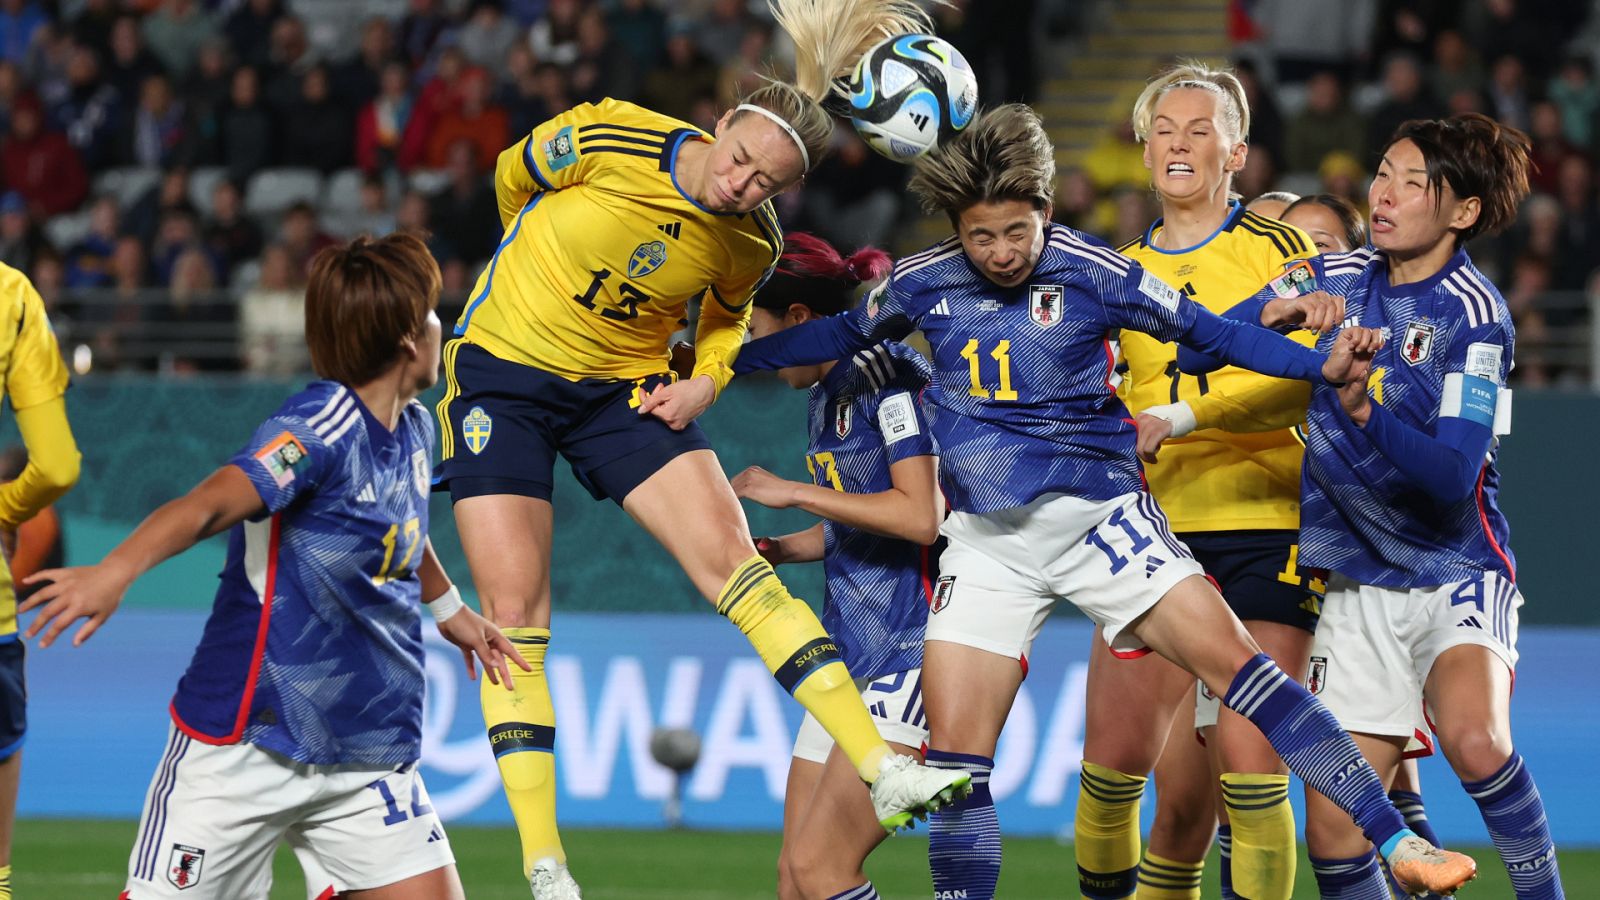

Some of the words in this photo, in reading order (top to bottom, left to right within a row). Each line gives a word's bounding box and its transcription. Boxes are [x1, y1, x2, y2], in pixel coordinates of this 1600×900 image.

[573, 268, 651, 322] 13
[959, 338, 1018, 401] 11
[1472, 388, 1491, 399] FIFA
[371, 517, 420, 586] 12
[1085, 505, 1154, 576] 11
[1450, 570, 1485, 614] 4
